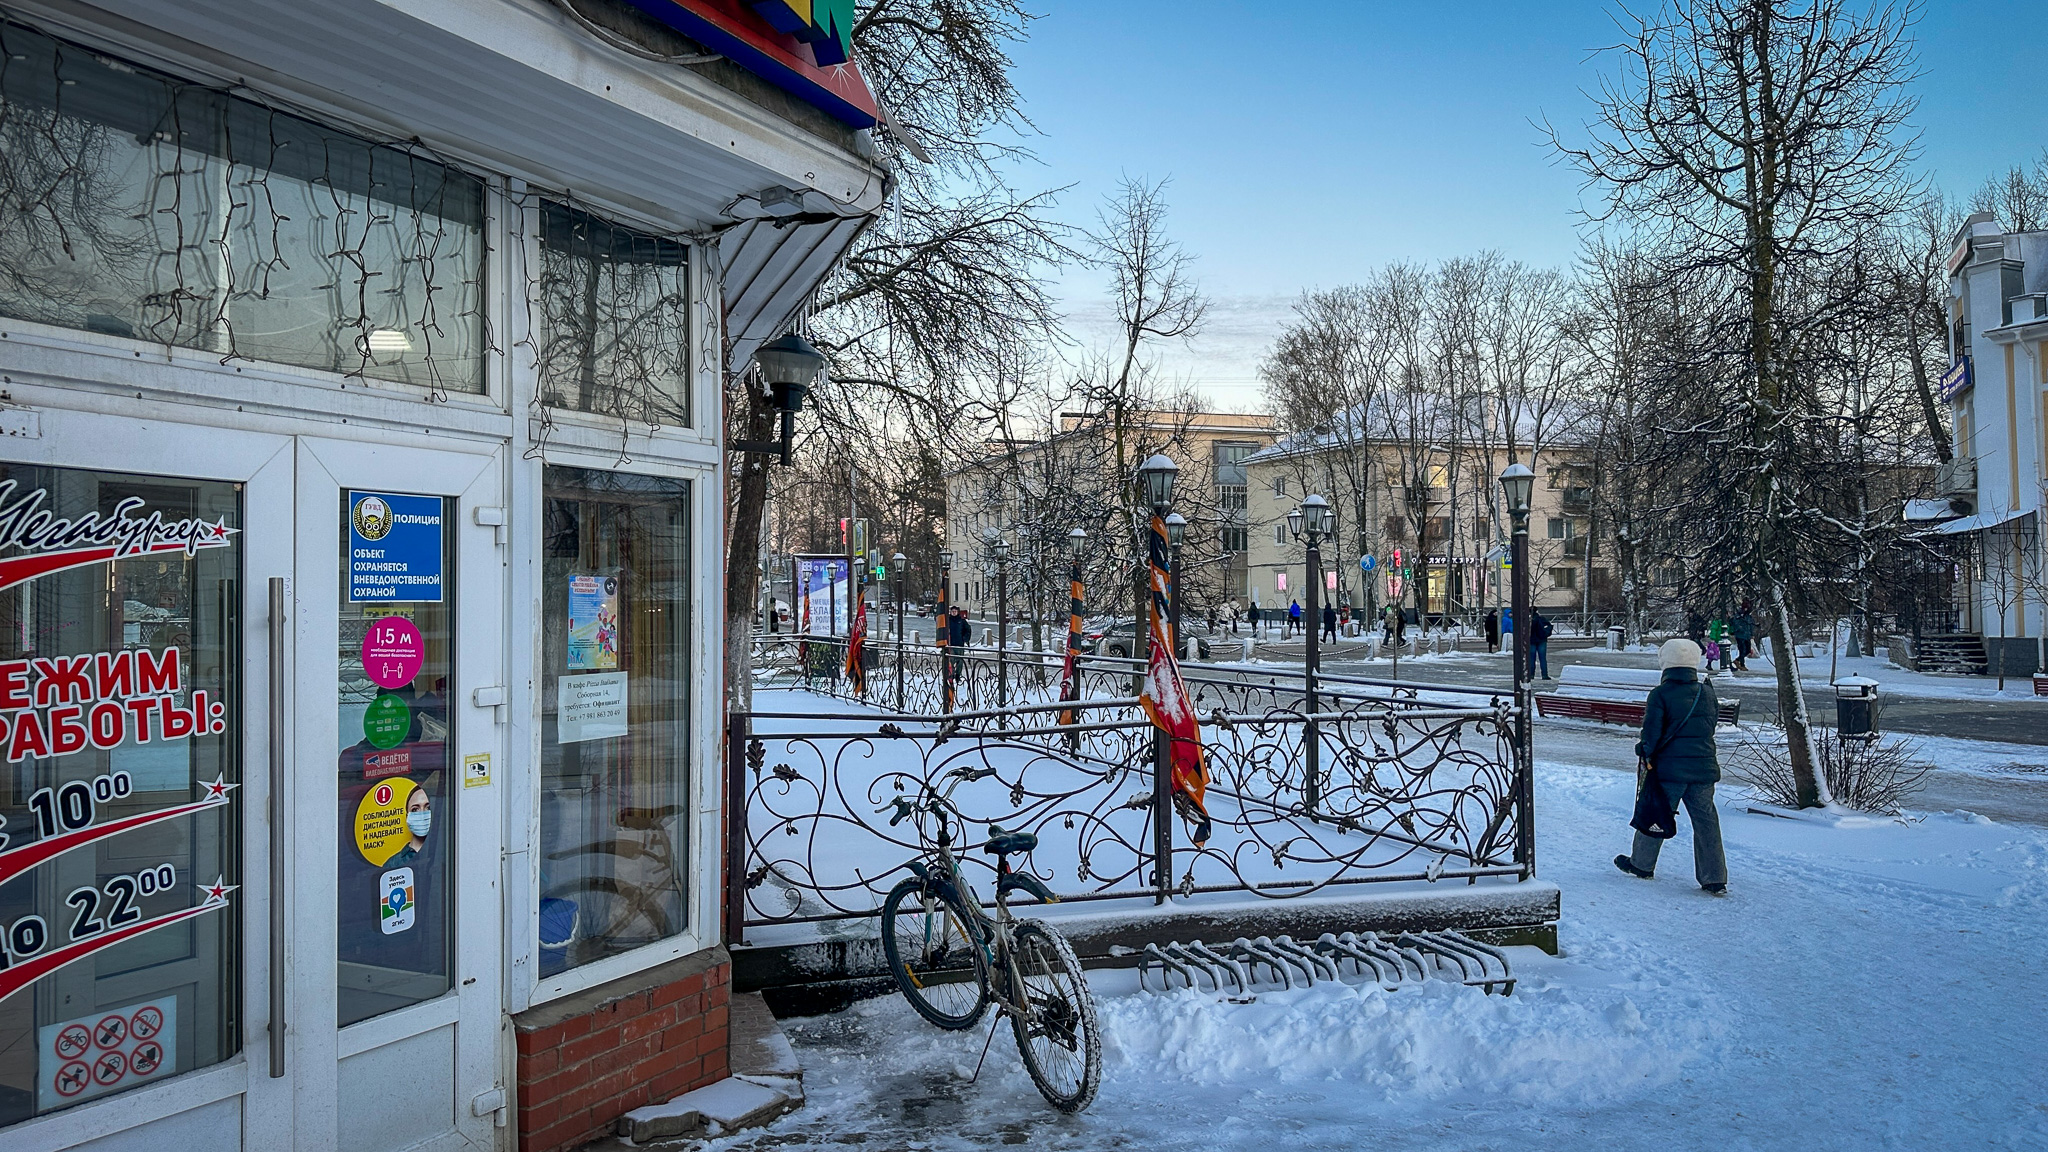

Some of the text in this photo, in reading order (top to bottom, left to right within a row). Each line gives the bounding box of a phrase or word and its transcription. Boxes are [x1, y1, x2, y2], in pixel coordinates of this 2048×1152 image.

[365, 503, 382, 512] ГУВД
[394, 514, 440, 526] ПОЛИЦИЯ
[353, 549, 386, 559] ОБЪЕКТ
[353, 562, 408, 572] ОХРАНЯЕТСЯ
[353, 574, 440, 586] ВНЕВЕДОМСТВЕННОЙ
[353, 586, 396, 597] ОХРАНОЙ
[376, 628, 395, 647] 1,5
[0, 647, 181, 711] ЕЖИМ
[0, 690, 226, 763] АБОТЫ:
[381, 753, 409, 765] ВЕДЁТСЯ
[365, 765, 409, 777] ВИДЕОНАБЛЮДЕНИЕ
[363, 808, 404, 820] СОБЛЮДАЙТЕ
[363, 818, 401, 831] ДИСТАНЦИЮ
[369, 827, 404, 839] НАДЕВАЙТЕ
